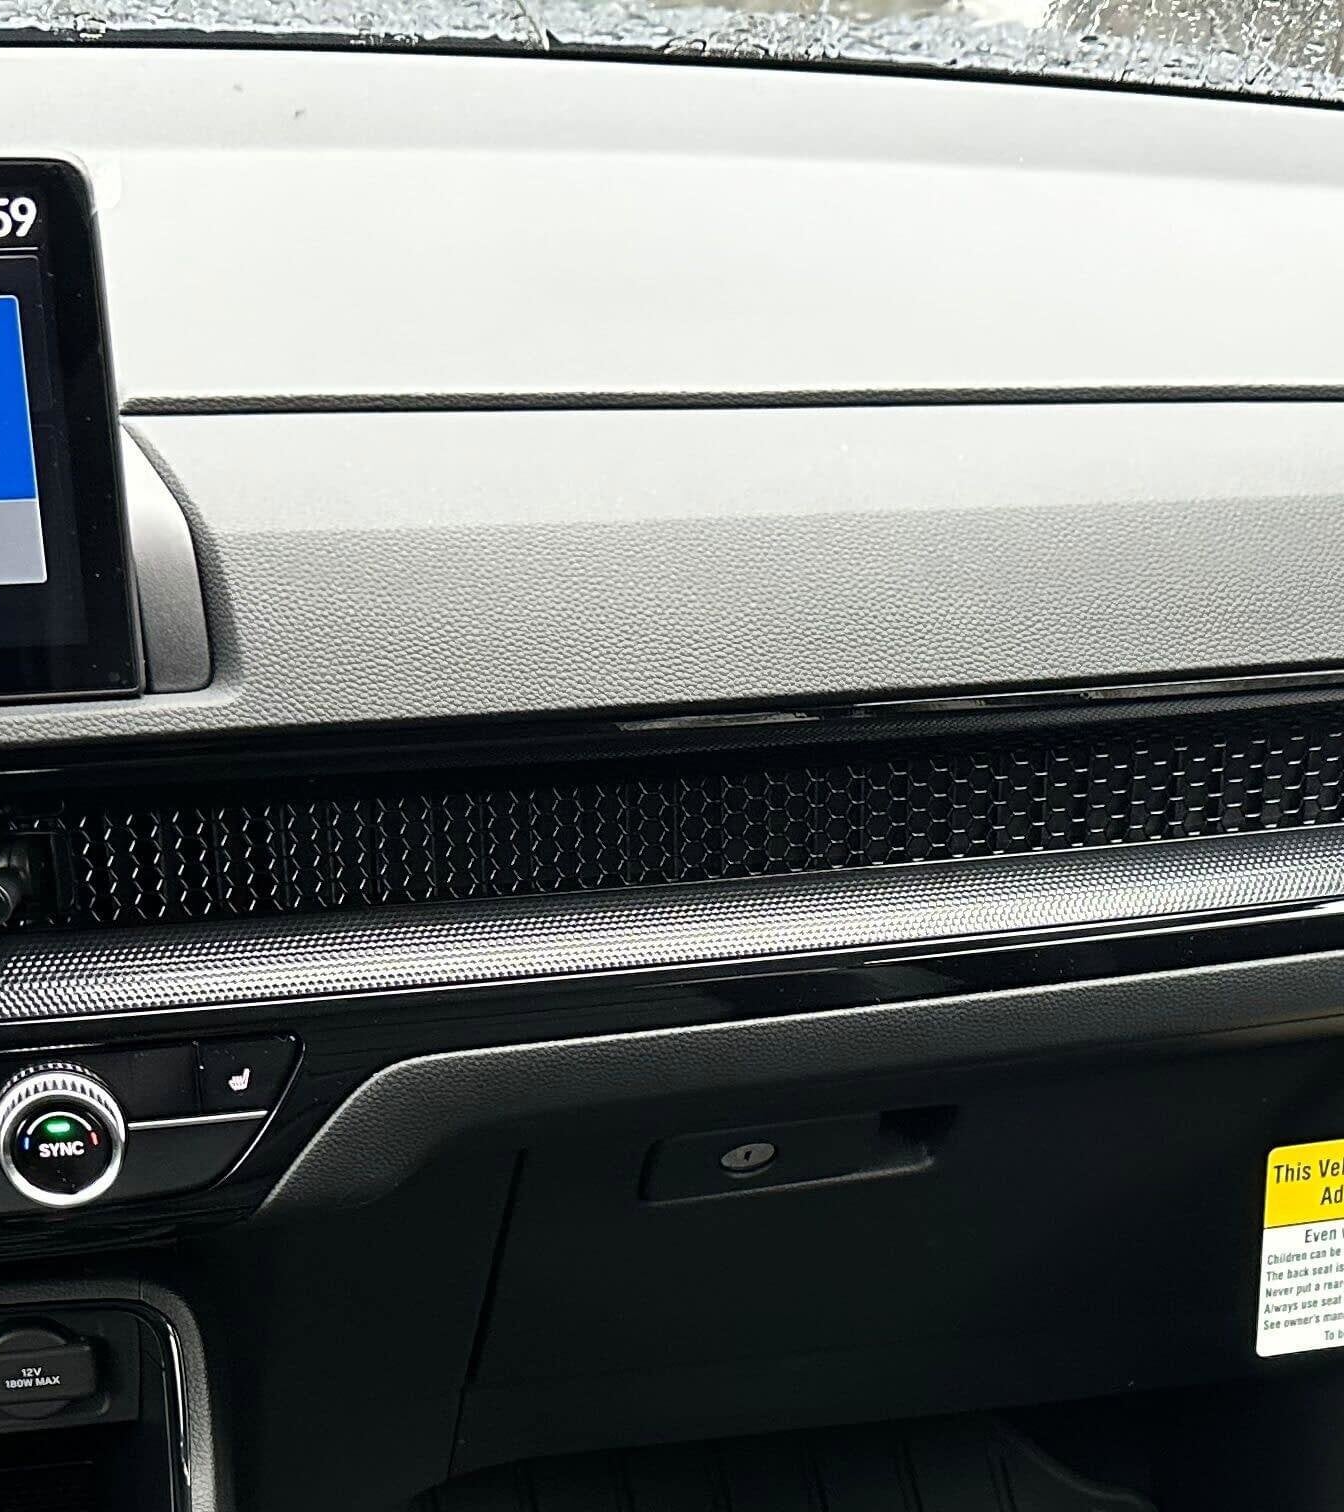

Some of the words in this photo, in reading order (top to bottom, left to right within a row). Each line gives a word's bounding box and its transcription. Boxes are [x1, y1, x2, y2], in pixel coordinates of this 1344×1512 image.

[39, 1141, 85, 1158] SYNC
[1273, 1162, 1311, 1184] This
[1305, 1228, 1337, 1243] Even
[1267, 1251, 1307, 1266] Children
[1310, 1250, 1327, 1260] can
[1330, 1246, 1341, 1257] be
[1266, 1271, 1284, 1282] The
[1287, 1267, 1309, 1279] back
[1312, 1264, 1333, 1276] seat
[1336, 1263, 1344, 1272] is
[1266, 1286, 1294, 1298] Never
[1296, 1283, 1311, 1296] put
[1264, 1301, 1298, 1314] Always
[1302, 1299, 1318, 1309] use
[1321, 1295, 1342, 1306] seat
[1264, 1320, 1280, 1331] See
[1325, 1330, 1334, 1340] To
[21, 1367, 42, 1378] 12V
[5, 1377, 34, 1389] 180W
[35, 1375, 60, 1386] MAX
